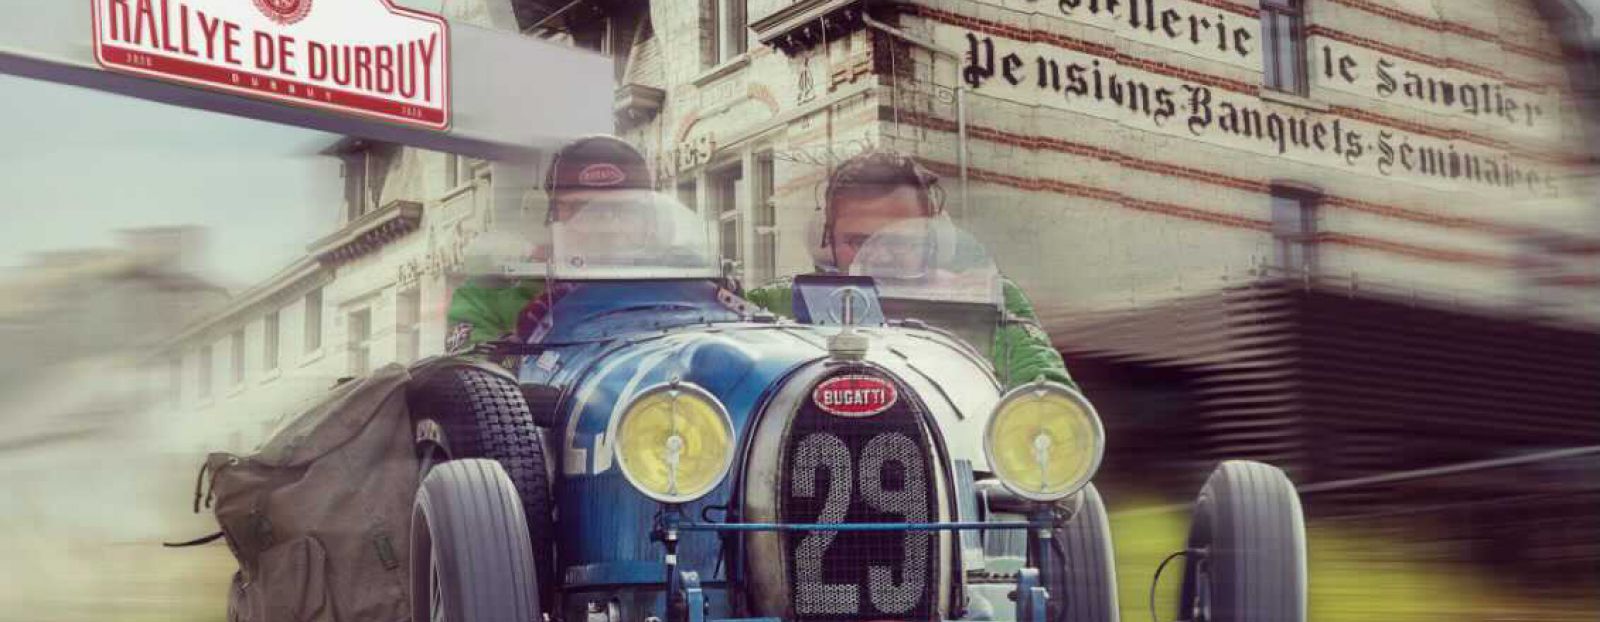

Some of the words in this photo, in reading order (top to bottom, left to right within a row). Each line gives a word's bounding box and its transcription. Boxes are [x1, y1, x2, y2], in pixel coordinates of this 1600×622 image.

[108, 0, 242, 65] RALLYE
[254, 30, 297, 77] DE
[307, 32, 437, 102] DURBUY
[962, 32, 1176, 127] Pensions
[1181, 84, 1364, 166] Banquets
[1324, 46, 1358, 83] le
[823, 388, 887, 406] BUGATTI
[791, 431, 930, 616] 29
